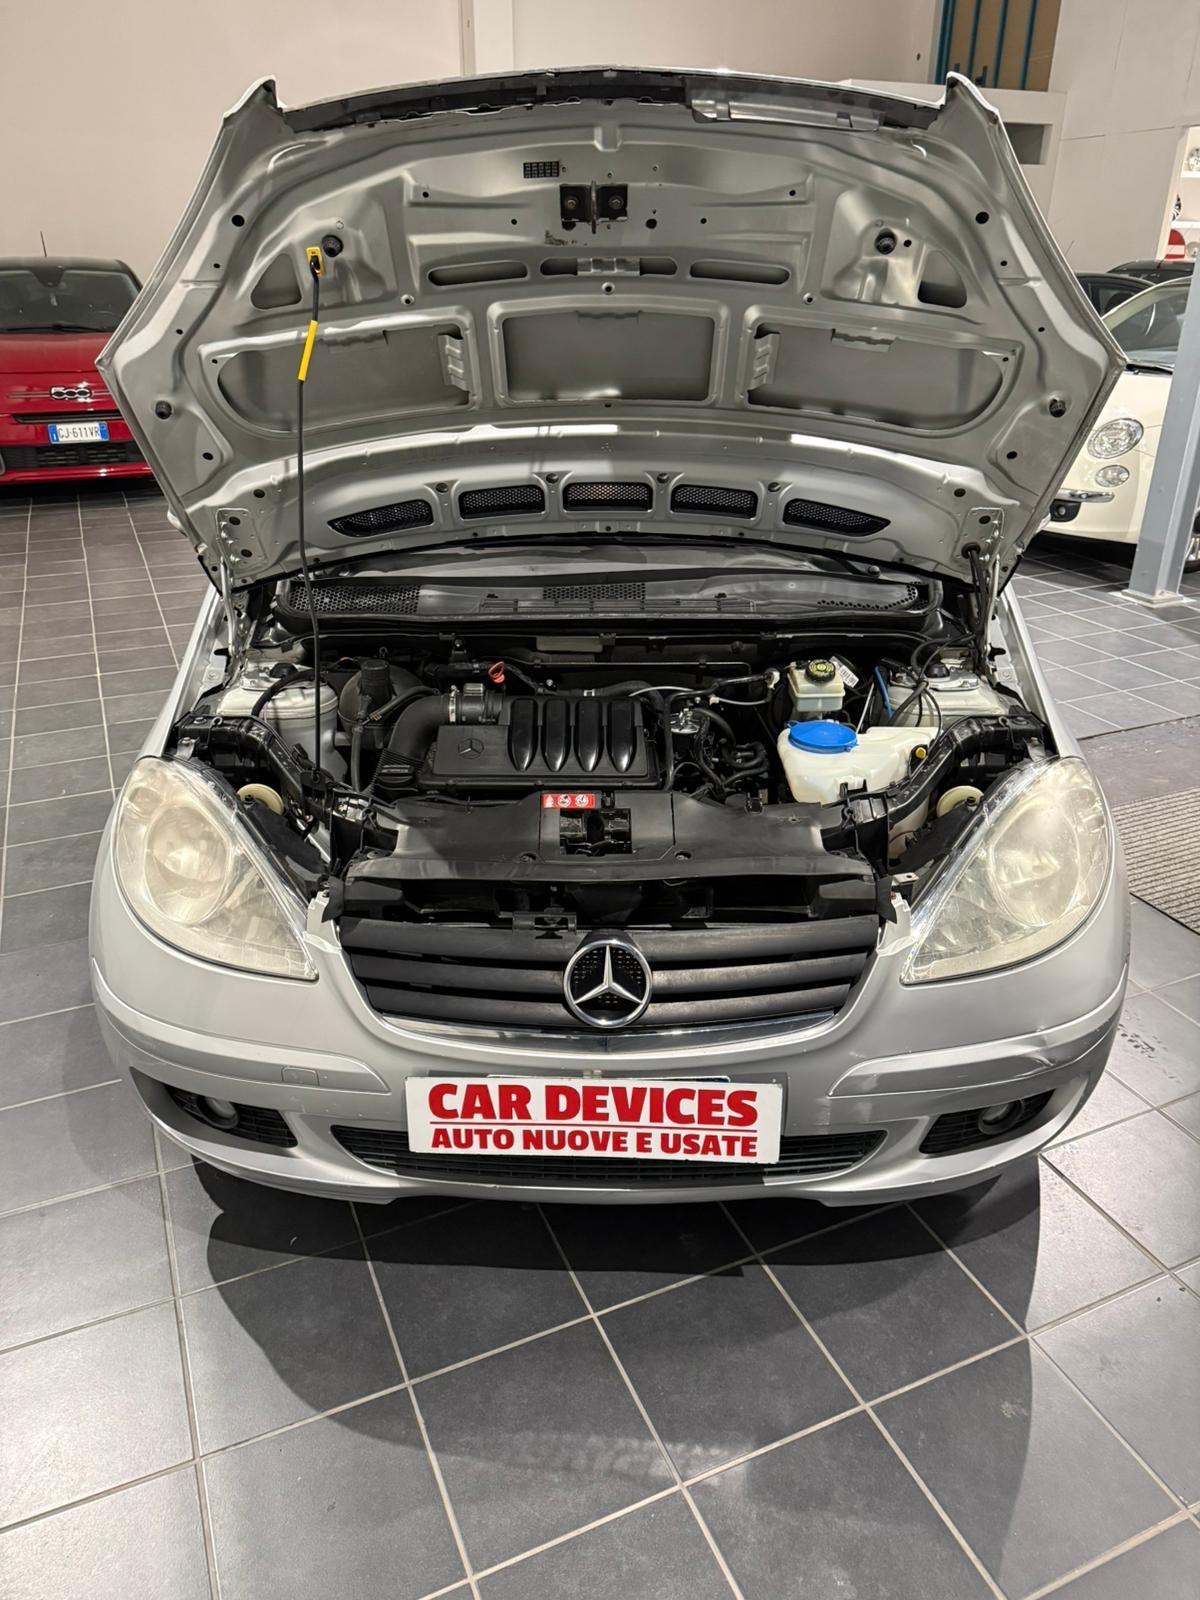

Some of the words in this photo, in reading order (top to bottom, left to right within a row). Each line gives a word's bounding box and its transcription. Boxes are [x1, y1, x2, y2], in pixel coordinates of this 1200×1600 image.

[428, 1083, 532, 1121] CAR
[544, 1084, 758, 1128] DEVICES
[431, 1127, 514, 1151] AUTO
[521, 1129, 629, 1153] NUOVE
[635, 1131, 652, 1153] E
[659, 1132, 757, 1158] USATE
